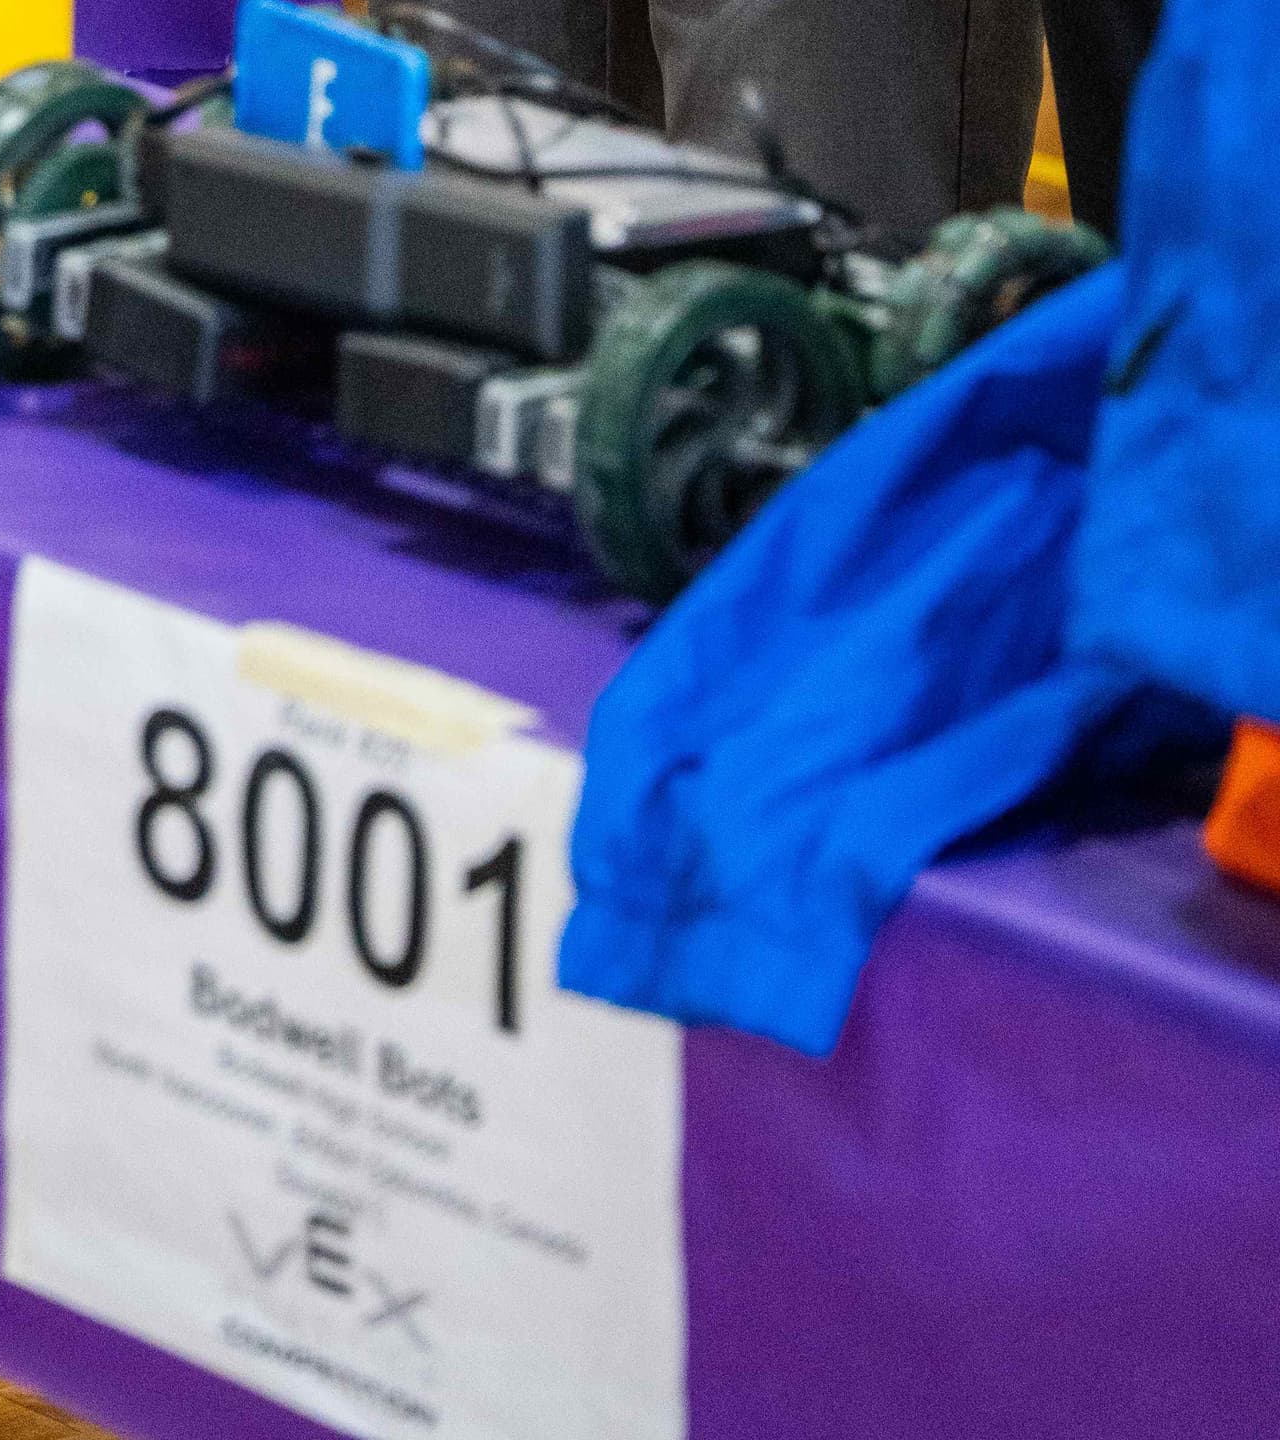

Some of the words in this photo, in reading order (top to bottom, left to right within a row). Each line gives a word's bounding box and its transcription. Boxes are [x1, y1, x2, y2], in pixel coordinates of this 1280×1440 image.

[136, 708, 526, 1034] 8001
[190, 959, 362, 1075] Bodwell
[377, 1041, 484, 1127] Bots
[228, 1211, 432, 1354] VEX
